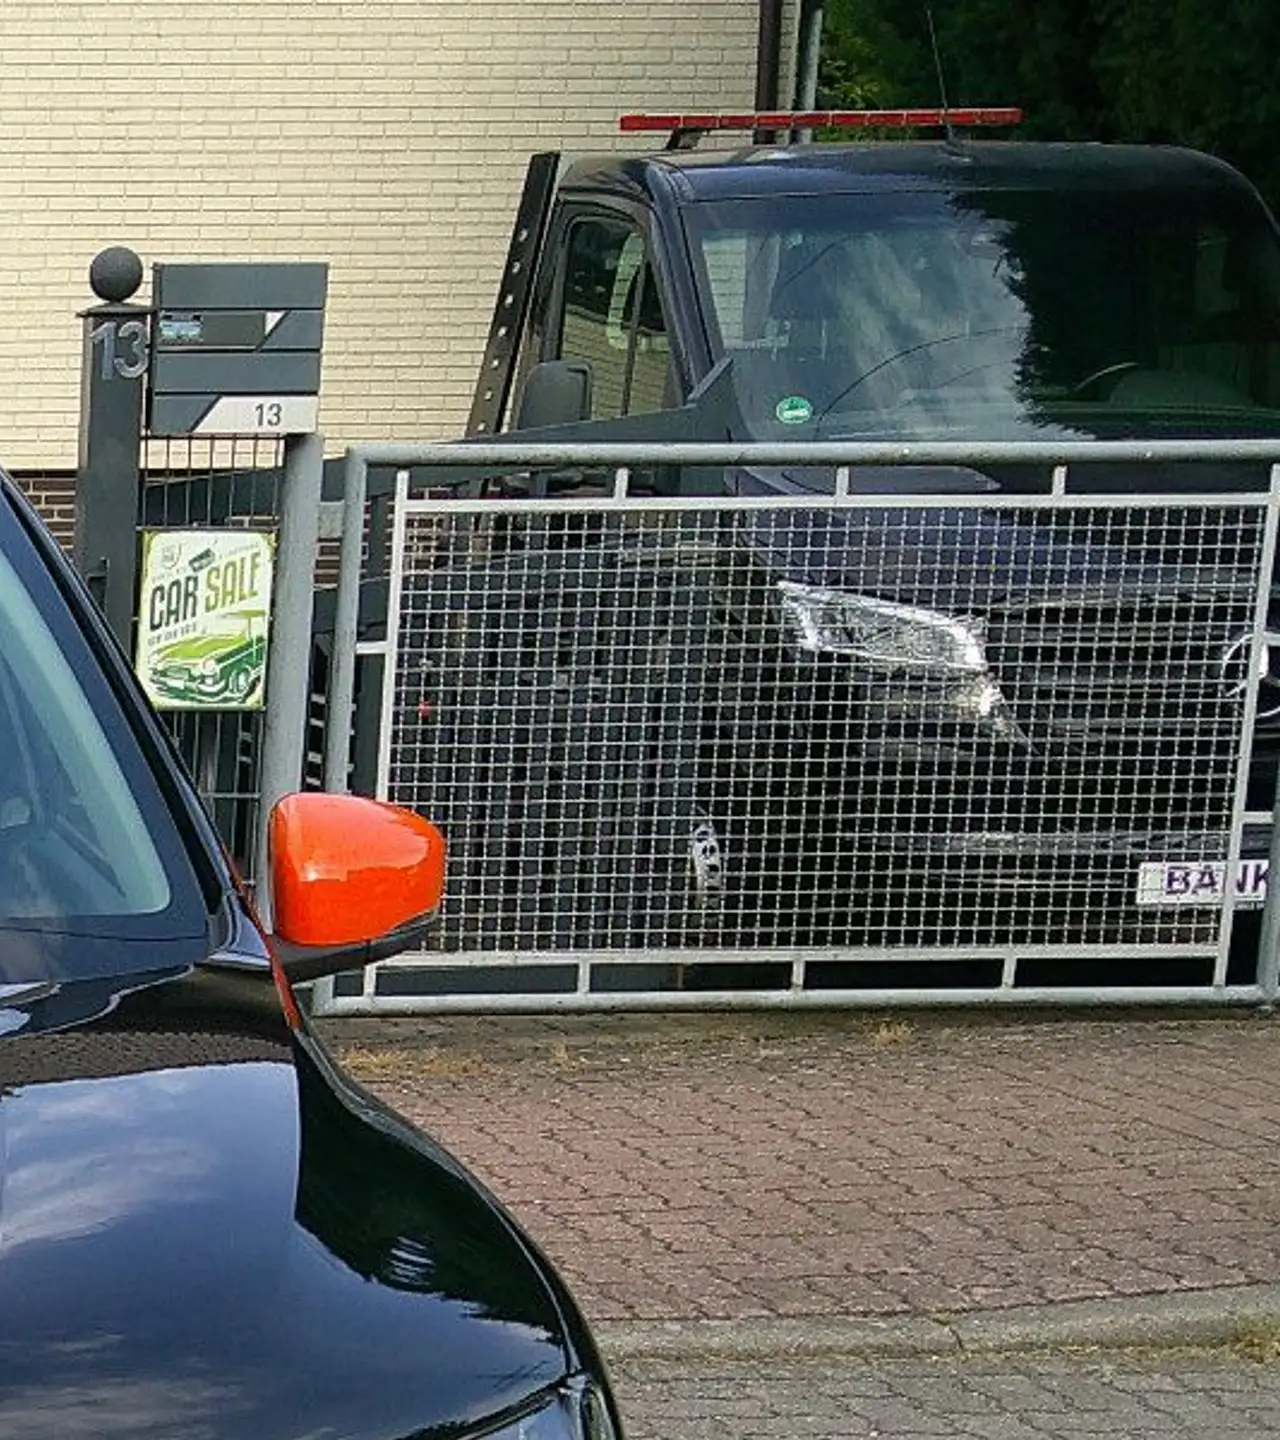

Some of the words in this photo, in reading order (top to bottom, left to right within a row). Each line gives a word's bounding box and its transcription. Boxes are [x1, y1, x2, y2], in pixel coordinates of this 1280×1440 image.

[90, 320, 149, 381] 13
[254, 402, 282, 426] 13
[150, 576, 199, 632] CAR
[204, 552, 262, 613] SALE
